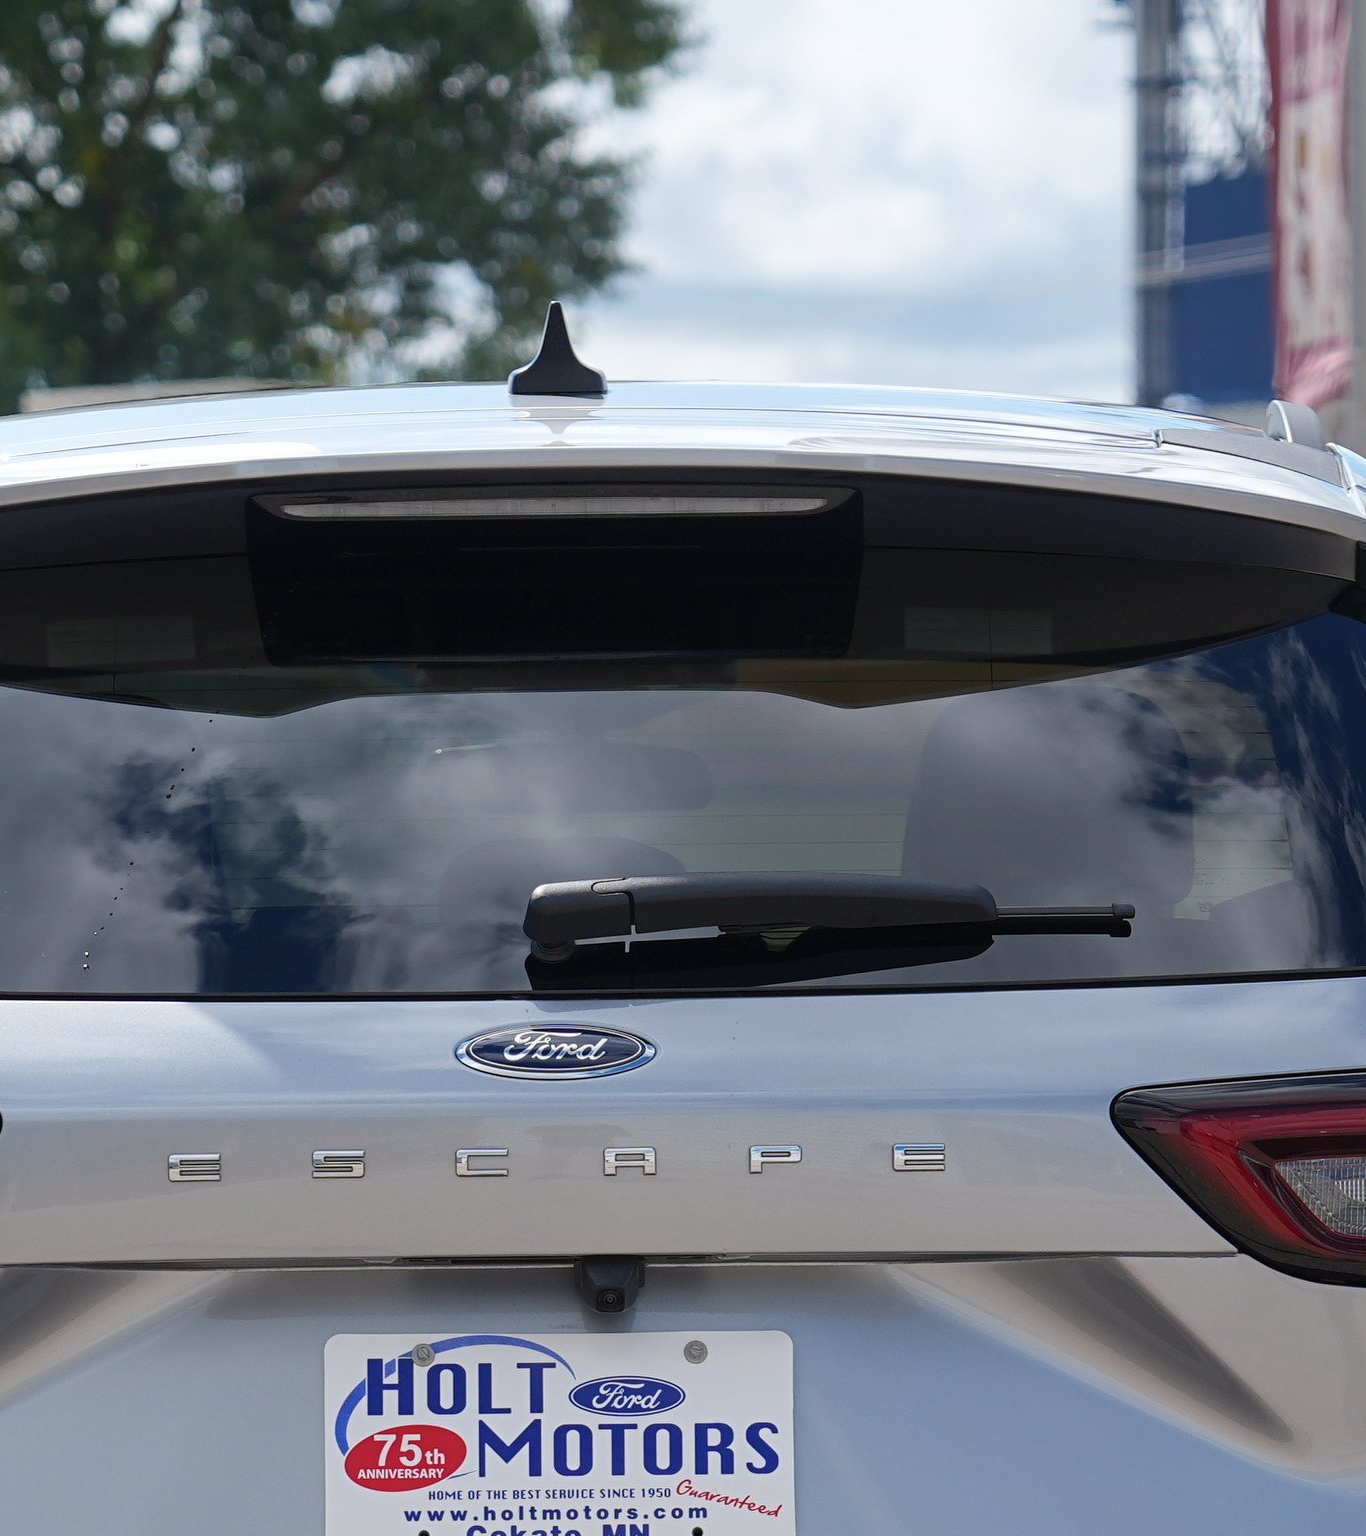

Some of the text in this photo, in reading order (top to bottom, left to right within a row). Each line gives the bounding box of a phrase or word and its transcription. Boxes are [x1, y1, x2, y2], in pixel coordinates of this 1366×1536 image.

[503, 1030, 607, 1063] Ford
[167, 1142, 947, 1183] ESCAPE
[367, 1358, 556, 1416] HOLT
[592, 1381, 663, 1409] Ford
[373, 1433, 446, 1467] 75th
[478, 1418, 780, 1477] MOTORS
[357, 1467, 445, 1480] ANNIVERSARY
[428, 1487, 672, 1501] HOME OF THE BEST SERVICE SINCE 1950
[676, 1479, 783, 1518] Guaranteed
[404, 1506, 708, 1522] www.holtmotors.com
